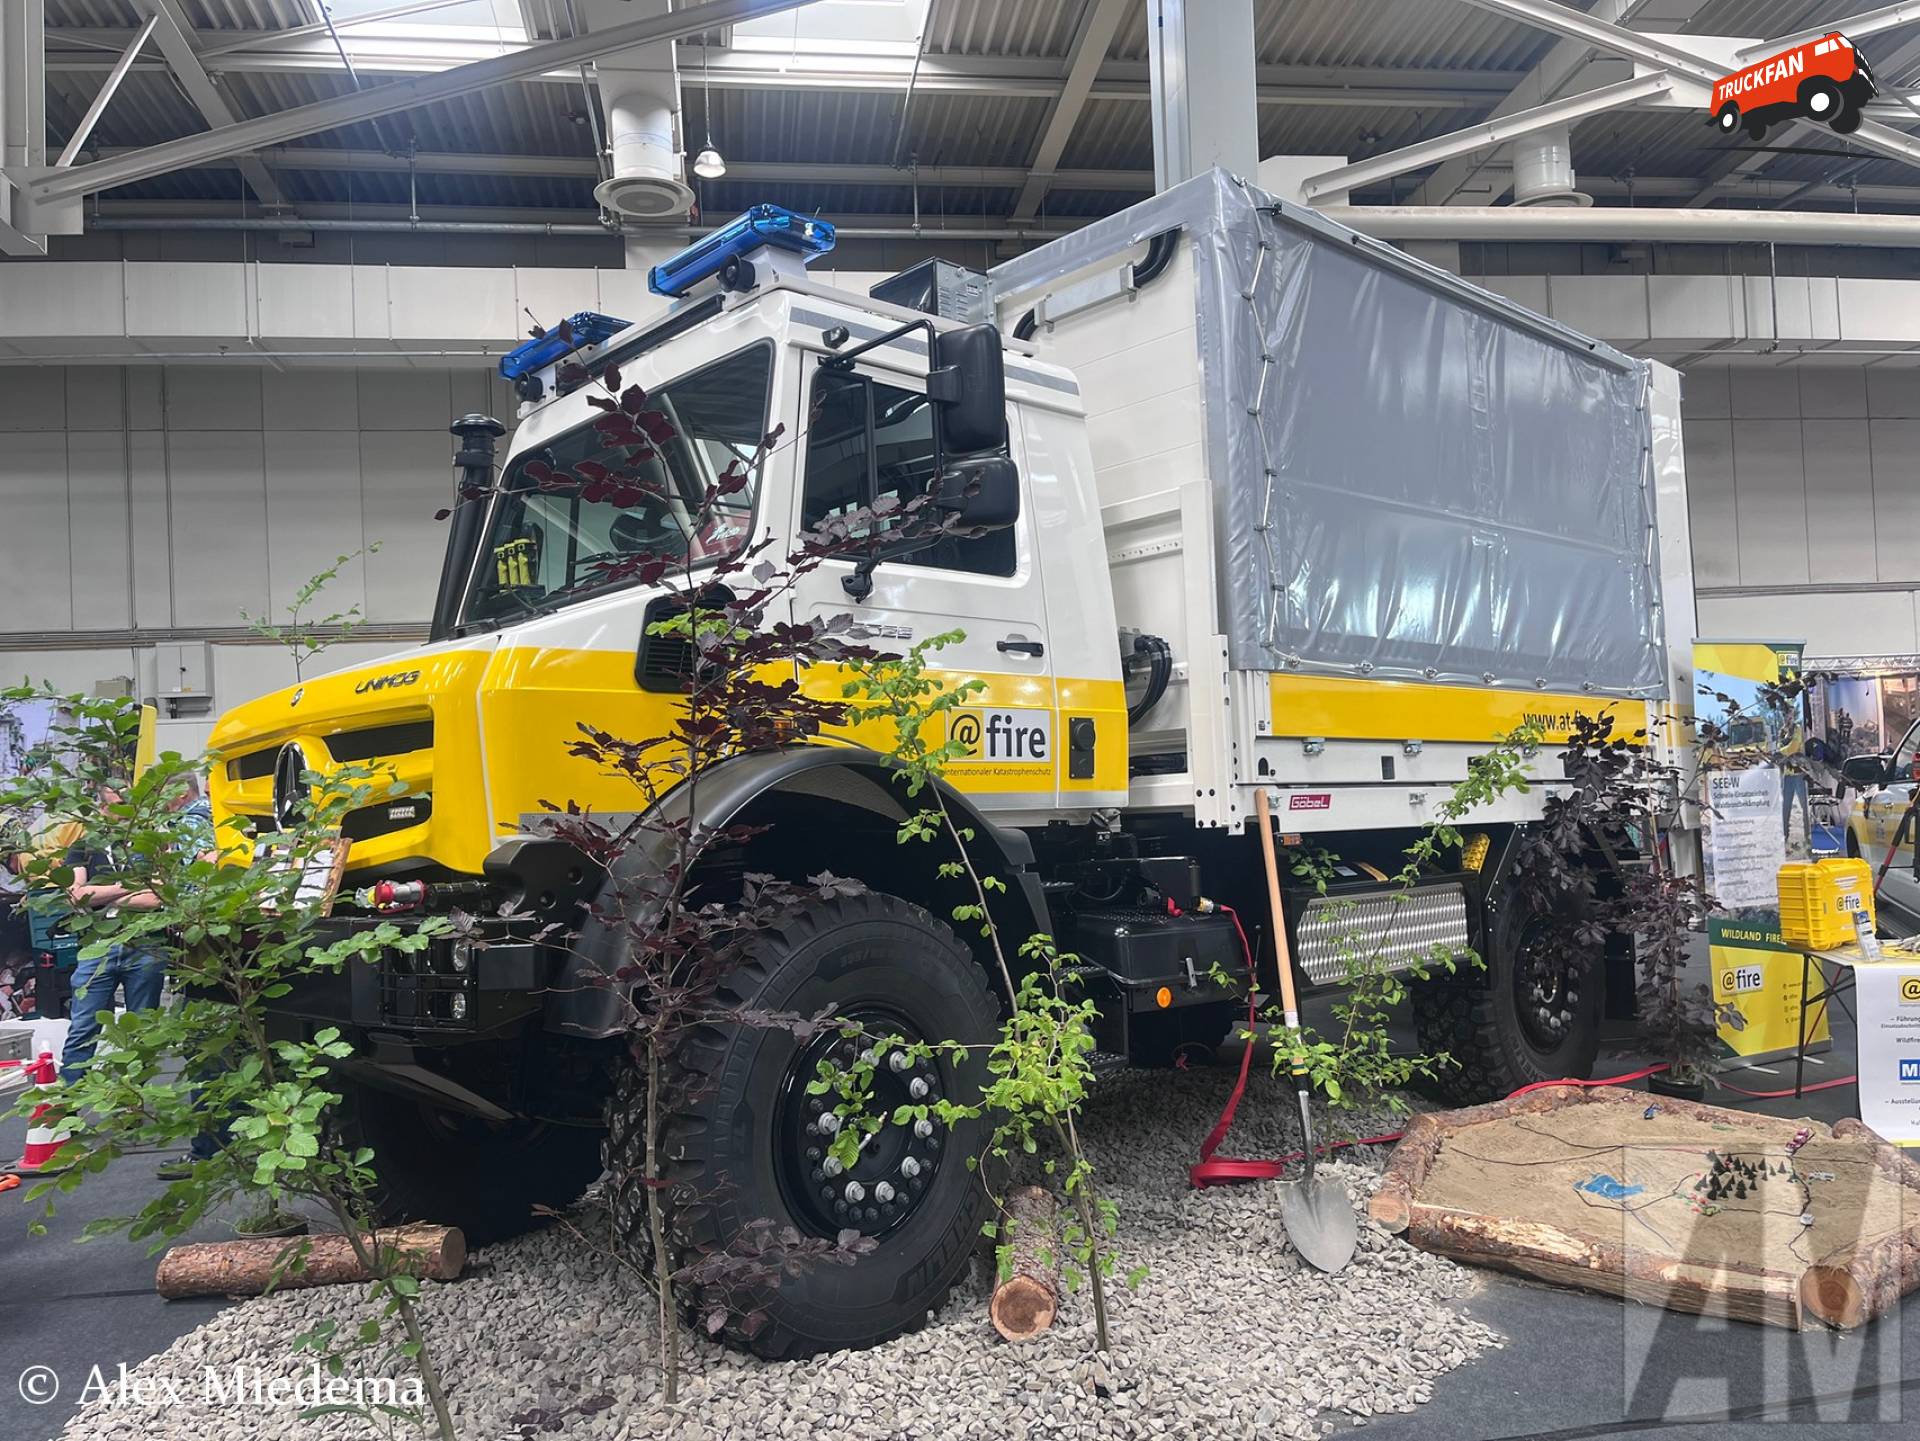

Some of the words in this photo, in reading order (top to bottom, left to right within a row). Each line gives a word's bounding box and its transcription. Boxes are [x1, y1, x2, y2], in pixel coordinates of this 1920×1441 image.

[355, 670, 420, 694] UNIMOG
[951, 714, 1046, 758] @fire
[993, 768, 1051, 777] Katastrophenschutz
[1713, 777, 1740, 789] SEE-W
[1837, 895, 1860, 911] @fire
[1721, 928, 1761, 941] WILDLAND
[1723, 969, 1760, 990] @fire
